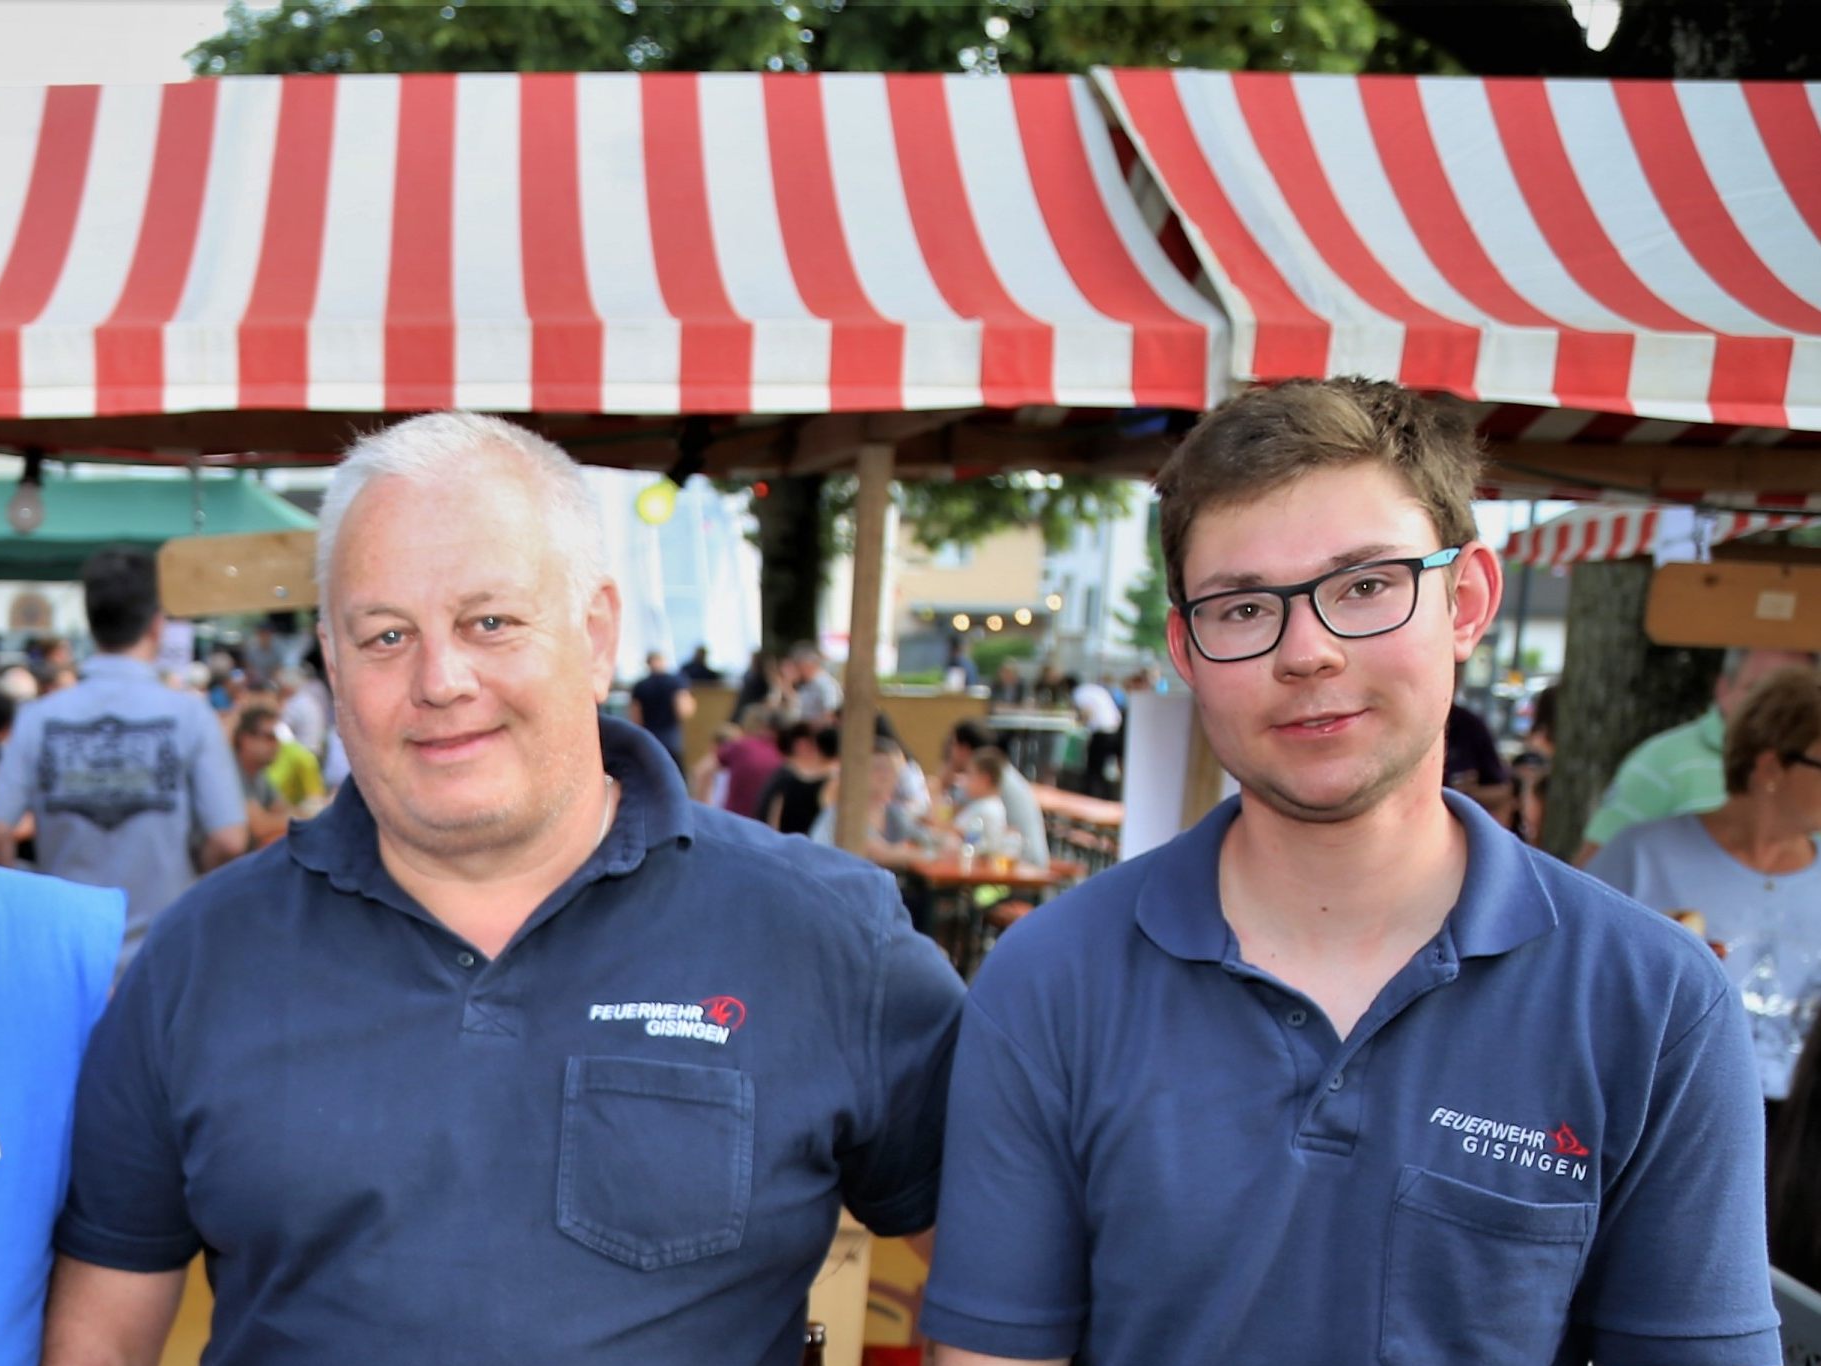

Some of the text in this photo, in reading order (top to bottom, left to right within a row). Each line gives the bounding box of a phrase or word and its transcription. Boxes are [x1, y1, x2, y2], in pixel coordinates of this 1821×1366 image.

[589, 1001, 704, 1022] FEUERWEHR
[645, 1020, 730, 1045] GISINGEN
[1429, 1106, 1547, 1150] FEUERWEHR
[1462, 1136, 1587, 1181] GISINGEN
